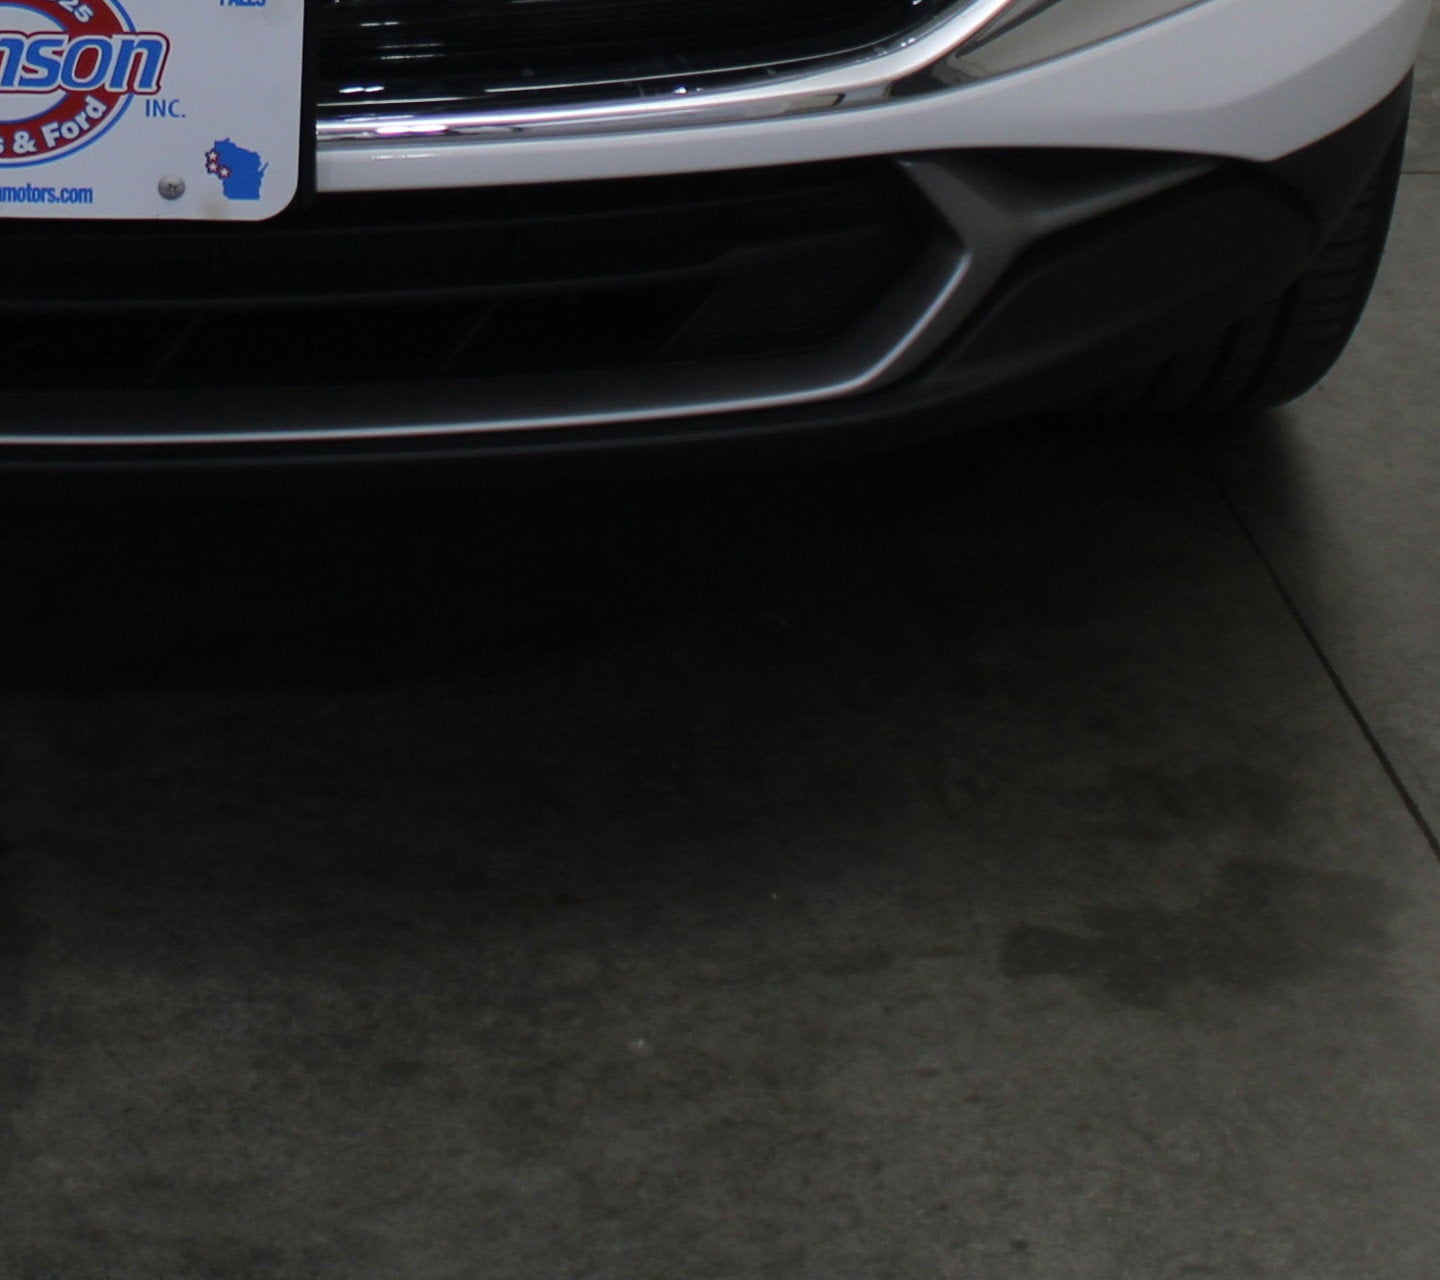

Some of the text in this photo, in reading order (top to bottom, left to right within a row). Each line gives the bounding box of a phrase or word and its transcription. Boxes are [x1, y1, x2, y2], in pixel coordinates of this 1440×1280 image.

[13, 133, 36, 154] &
[42, 95, 108, 149] Ford
[145, 99, 186, 119] INC.
